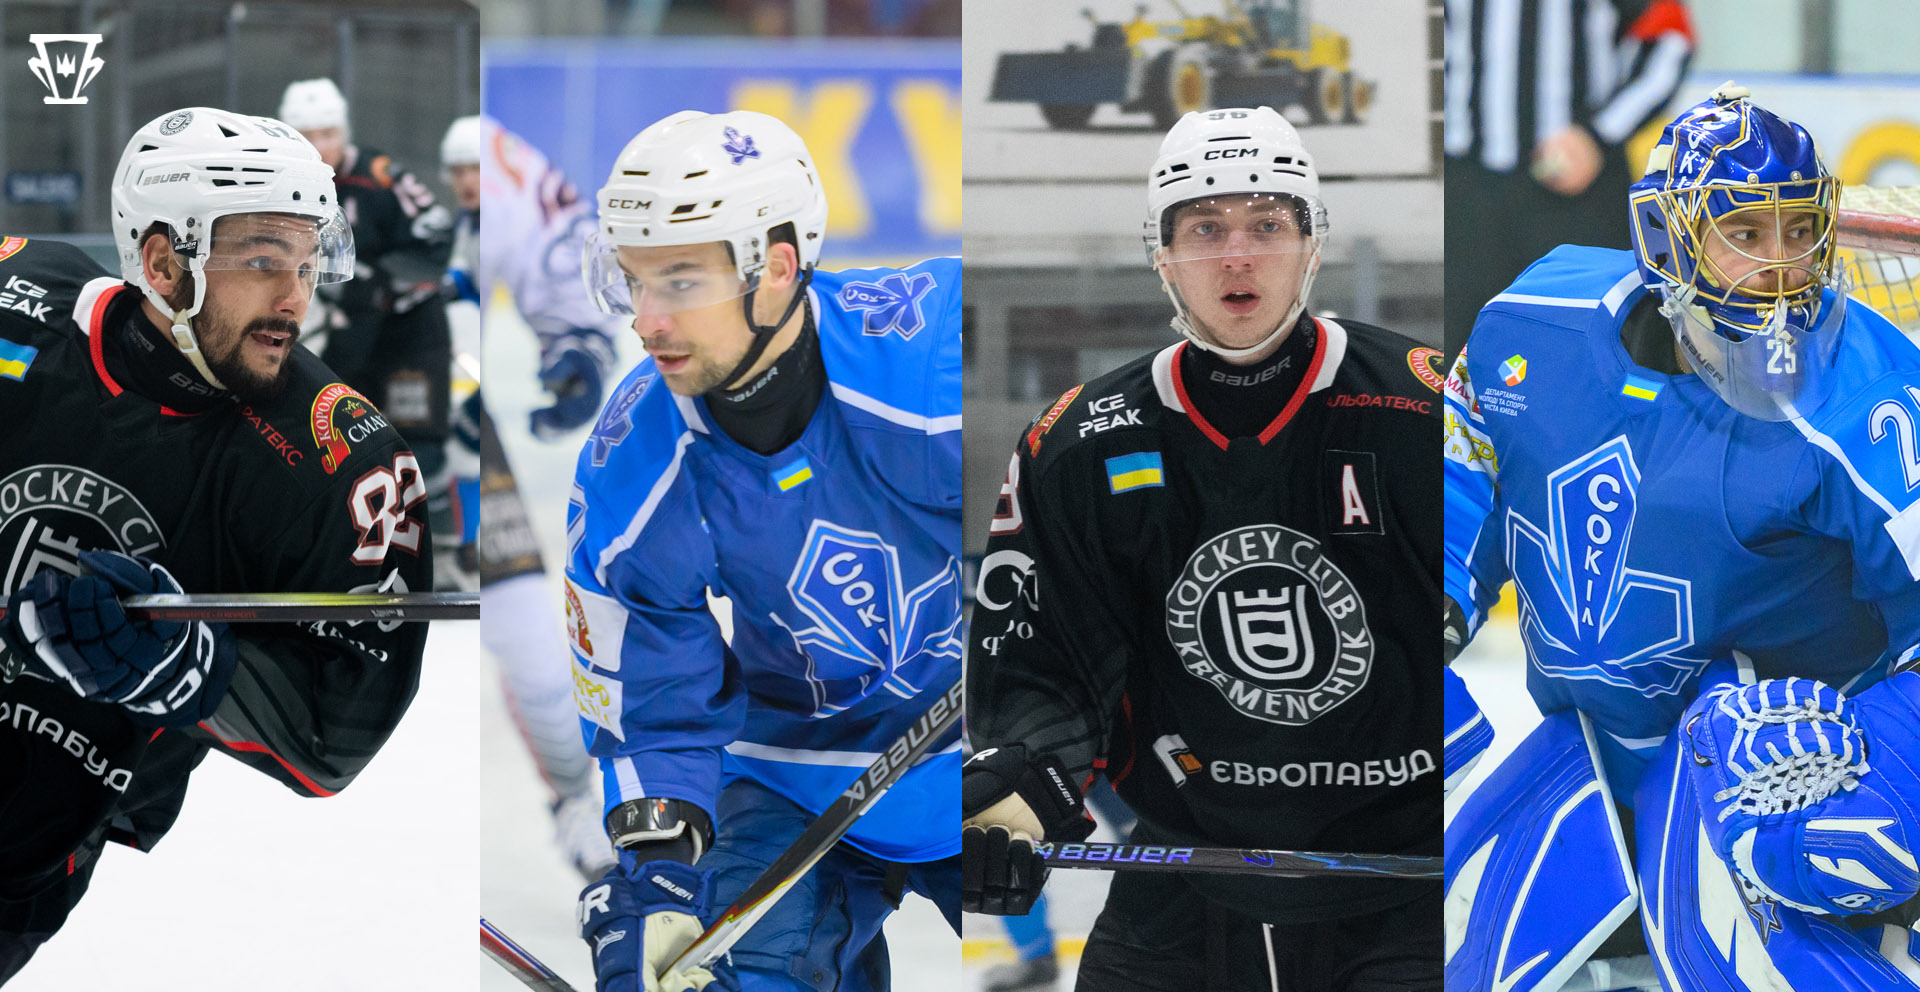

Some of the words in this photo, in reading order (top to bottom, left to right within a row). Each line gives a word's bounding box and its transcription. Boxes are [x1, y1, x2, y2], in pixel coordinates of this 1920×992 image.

[1204, 148, 1259, 161] CCM
[608, 198, 652, 210] CCM
[5, 275, 48, 299] ICE
[0, 292, 53, 322] EAK
[1766, 339, 1796, 374] 25
[1088, 393, 1126, 415] ICE
[1444, 376, 1471, 401] МАК
[1484, 388, 1526, 402] ДЕПАРТАМЕНТ
[1078, 409, 1143, 438] PEAK
[1342, 464, 1370, 525] A
[0, 471, 124, 516] OCKEY
[120, 517, 160, 557] CL
[1169, 530, 1281, 629] HOCKEY
[1291, 541, 1357, 620] CLUB
[822, 552, 889, 646] СОКІ
[1175, 628, 1369, 720] KREMENCHUK
[0, 701, 133, 794] ПАБУД
[1210, 749, 1436, 788] ЄВРОПАБУД
